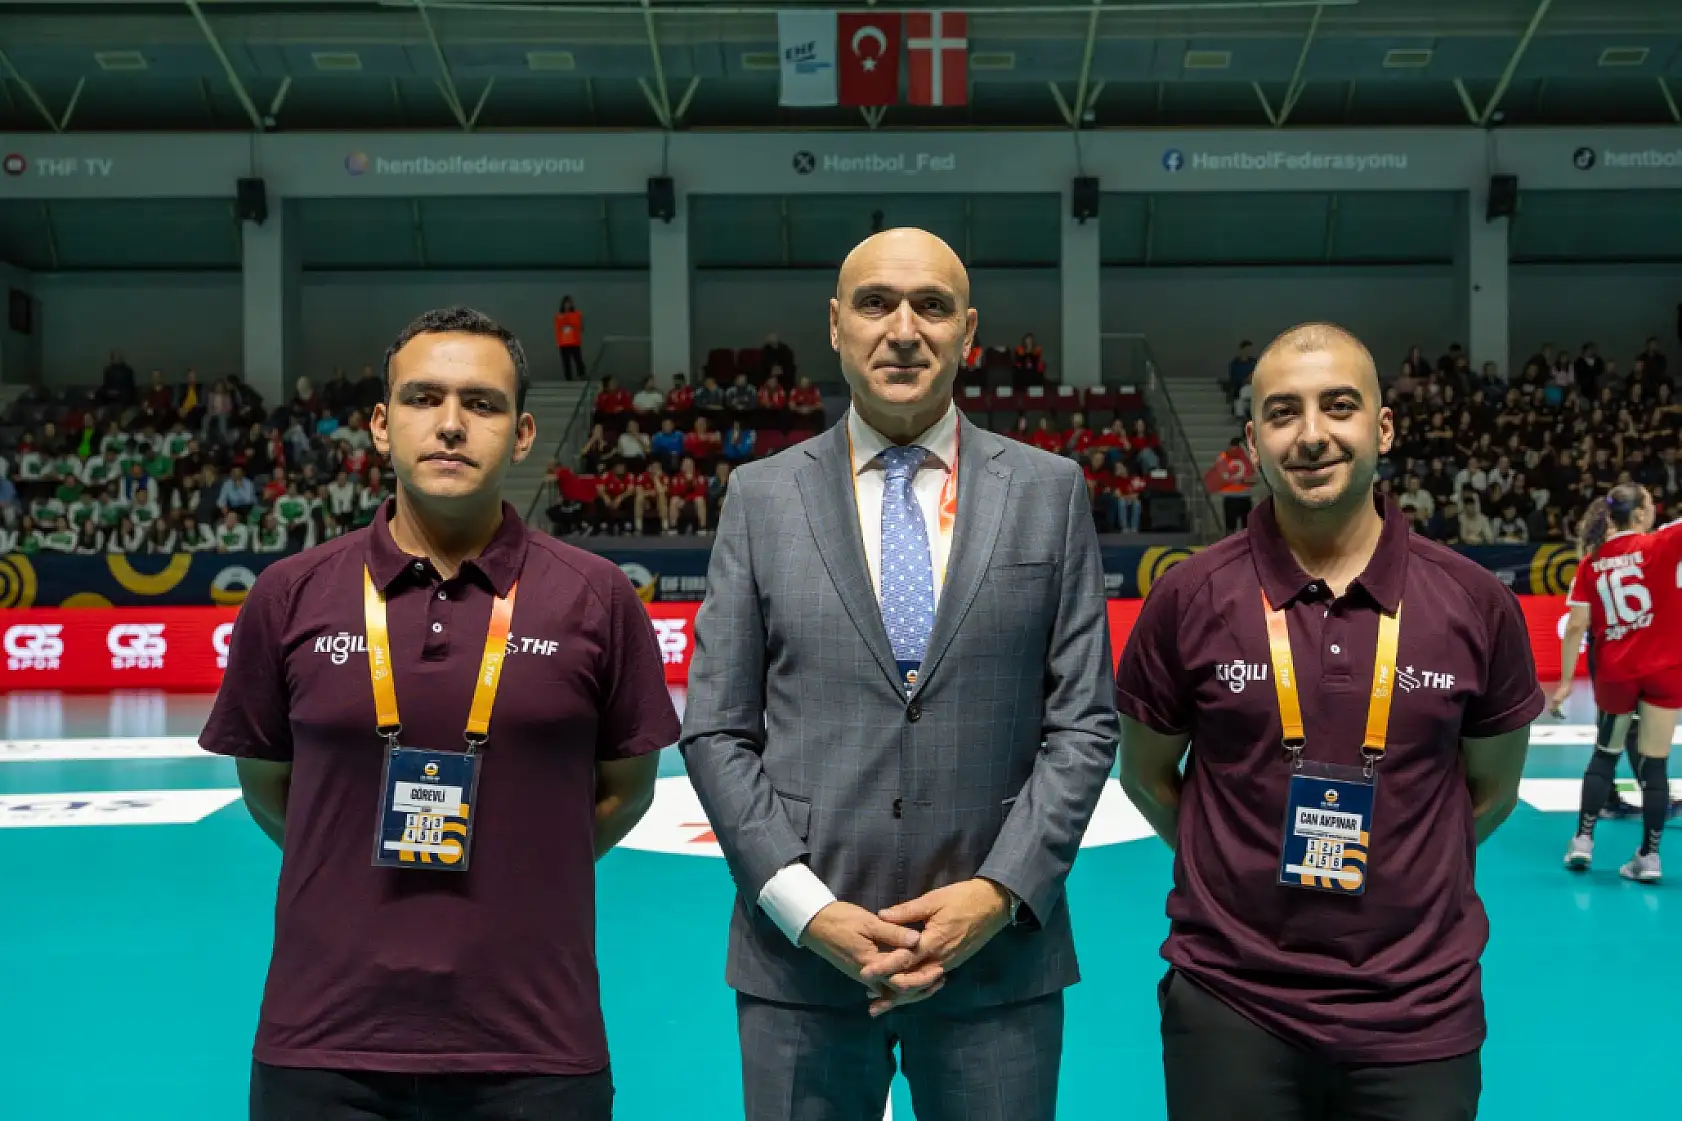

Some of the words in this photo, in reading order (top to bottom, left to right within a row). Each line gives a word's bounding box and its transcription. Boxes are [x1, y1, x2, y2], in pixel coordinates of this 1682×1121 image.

[36, 158, 78, 177] THF
[84, 158, 113, 177] TV
[376, 155, 585, 177] hentbolfederasyonu
[822, 152, 957, 175] Hentbol_Fed
[1192, 151, 1409, 173] HentbolFederasyonu
[1596, 565, 1652, 627] 16
[520, 637, 559, 656] THF
[8, 656, 61, 670] SPOR
[111, 655, 165, 669] SPOR
[1421, 671, 1456, 690] THF
[1300, 811, 1318, 826] CAN
[1318, 814, 1358, 831] AKPINAR
